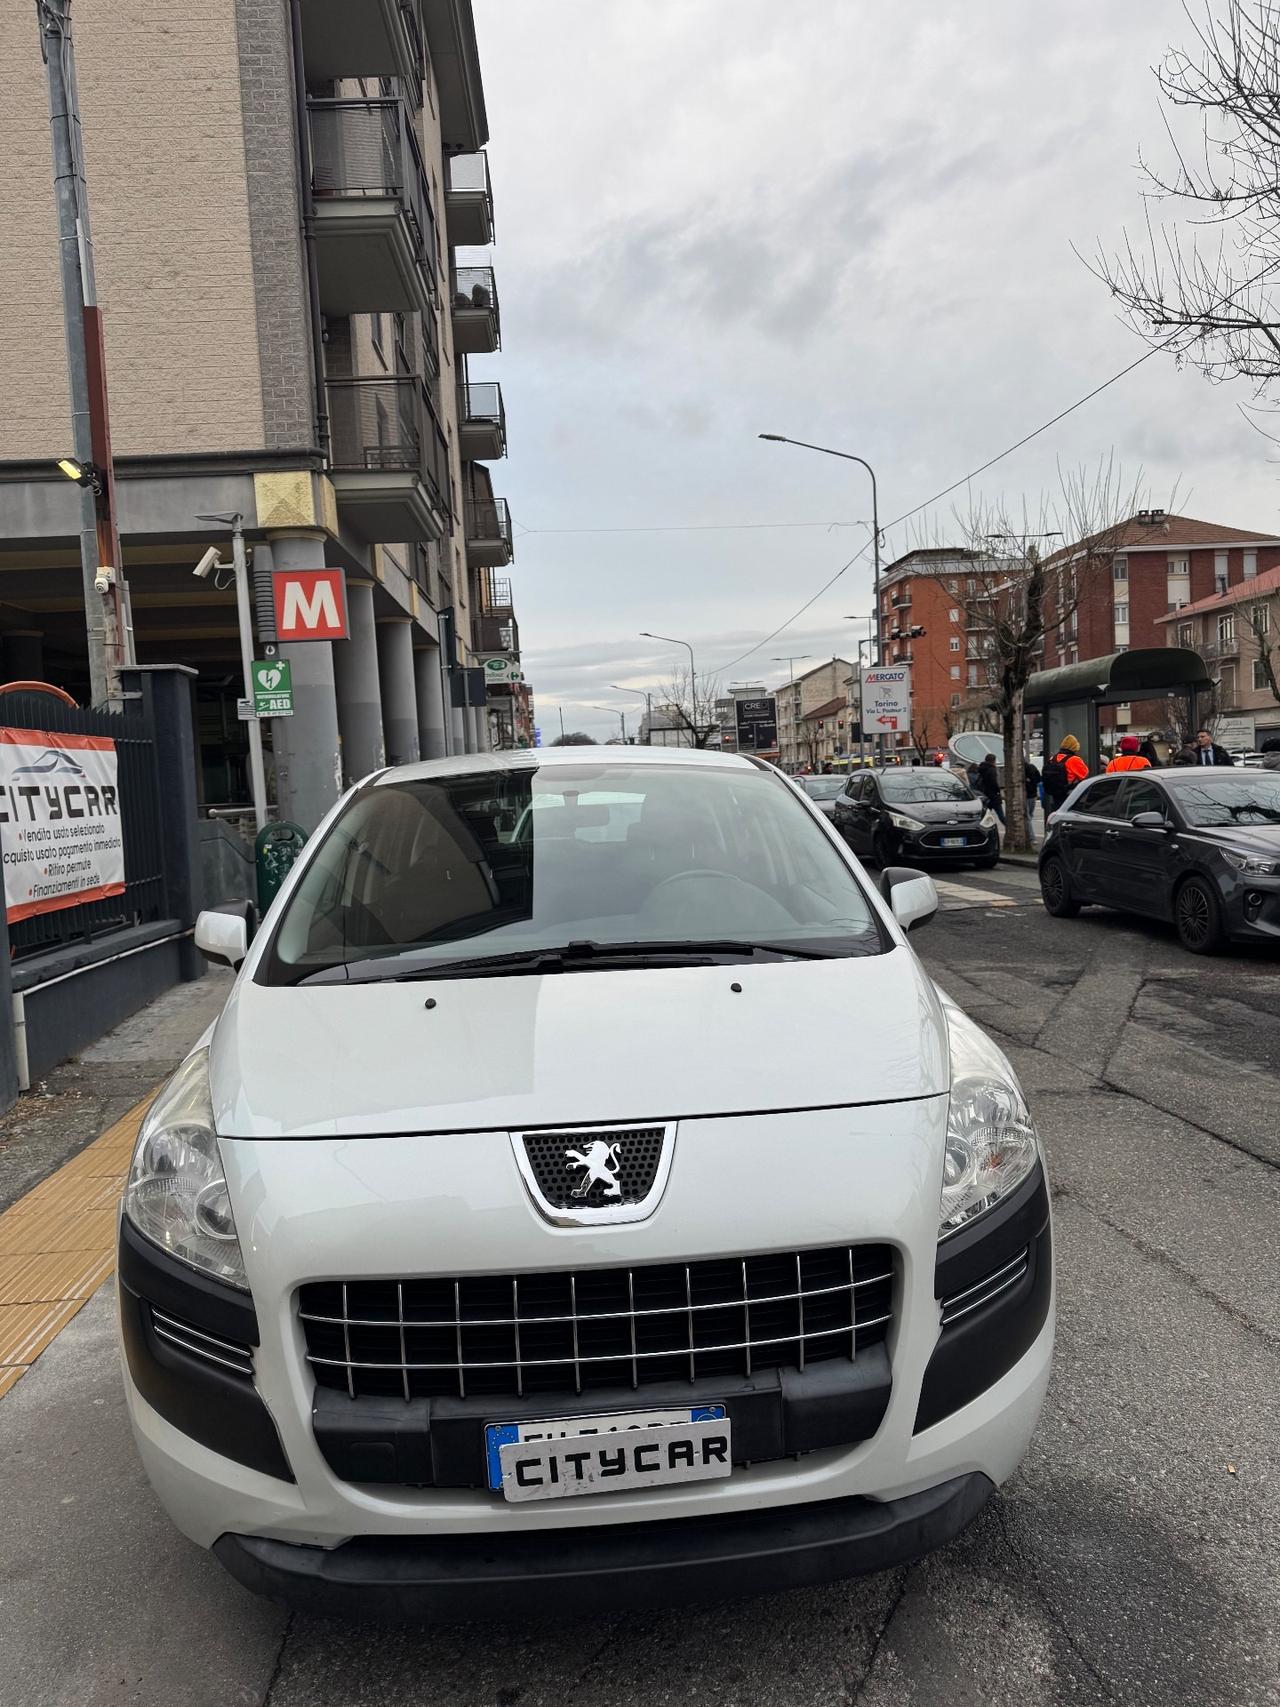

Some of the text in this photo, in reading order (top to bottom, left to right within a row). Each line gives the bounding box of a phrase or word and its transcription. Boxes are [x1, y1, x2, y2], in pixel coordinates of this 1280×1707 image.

[282, 580, 341, 629] M
[865, 672, 905, 683] MERCATO
[270, 699, 291, 710] AED
[874, 700, 898, 708] Torino
[21, 823, 105, 843] Vendita usato selezionato
[3, 837, 121, 866] cquisto usato pagamento immediato
[48, 859, 92, 877] Ritiro permute
[33, 873, 101, 898] Finanziamenti in sede
[515, 1435, 728, 1487] CITYCAR
